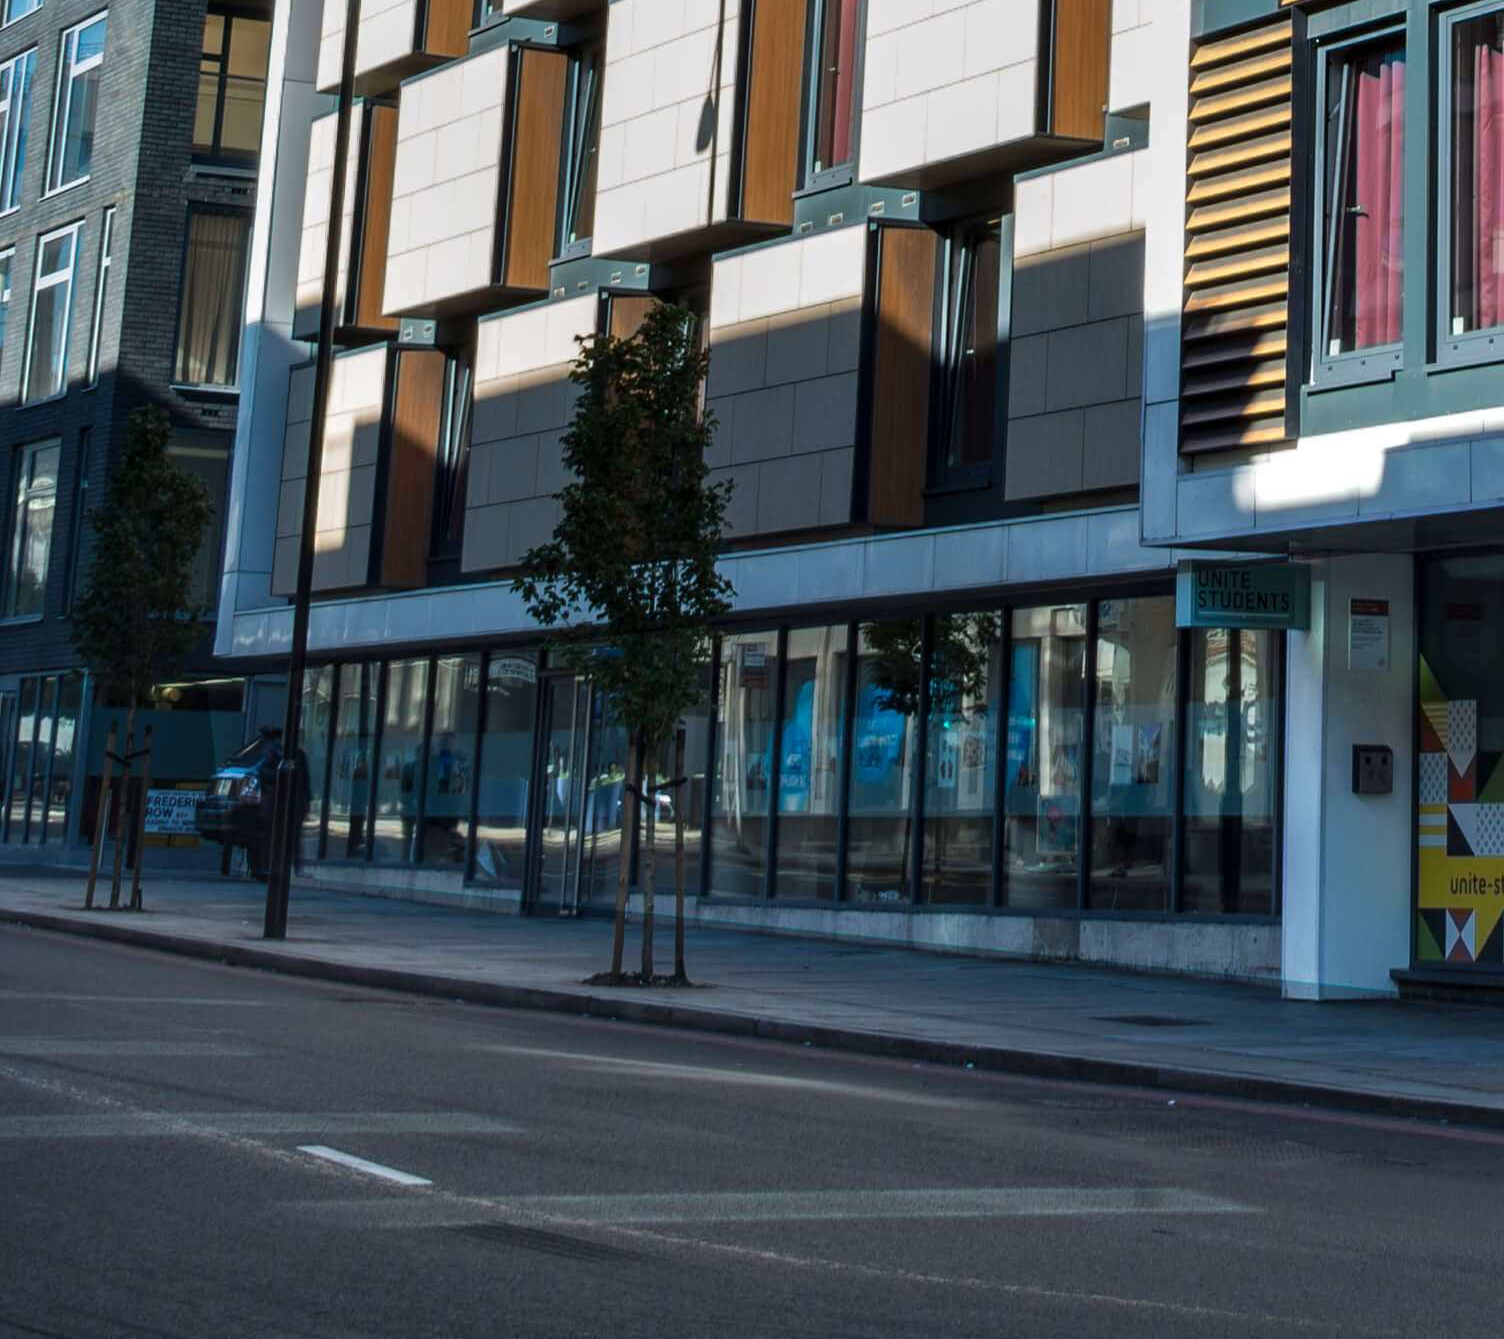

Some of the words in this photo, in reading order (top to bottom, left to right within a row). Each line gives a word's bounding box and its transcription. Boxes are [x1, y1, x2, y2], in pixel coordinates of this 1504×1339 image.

[1198, 570, 1250, 589] UNITE
[1198, 590, 1291, 612] STUDENTS
[146, 795, 198, 808] FREDERI
